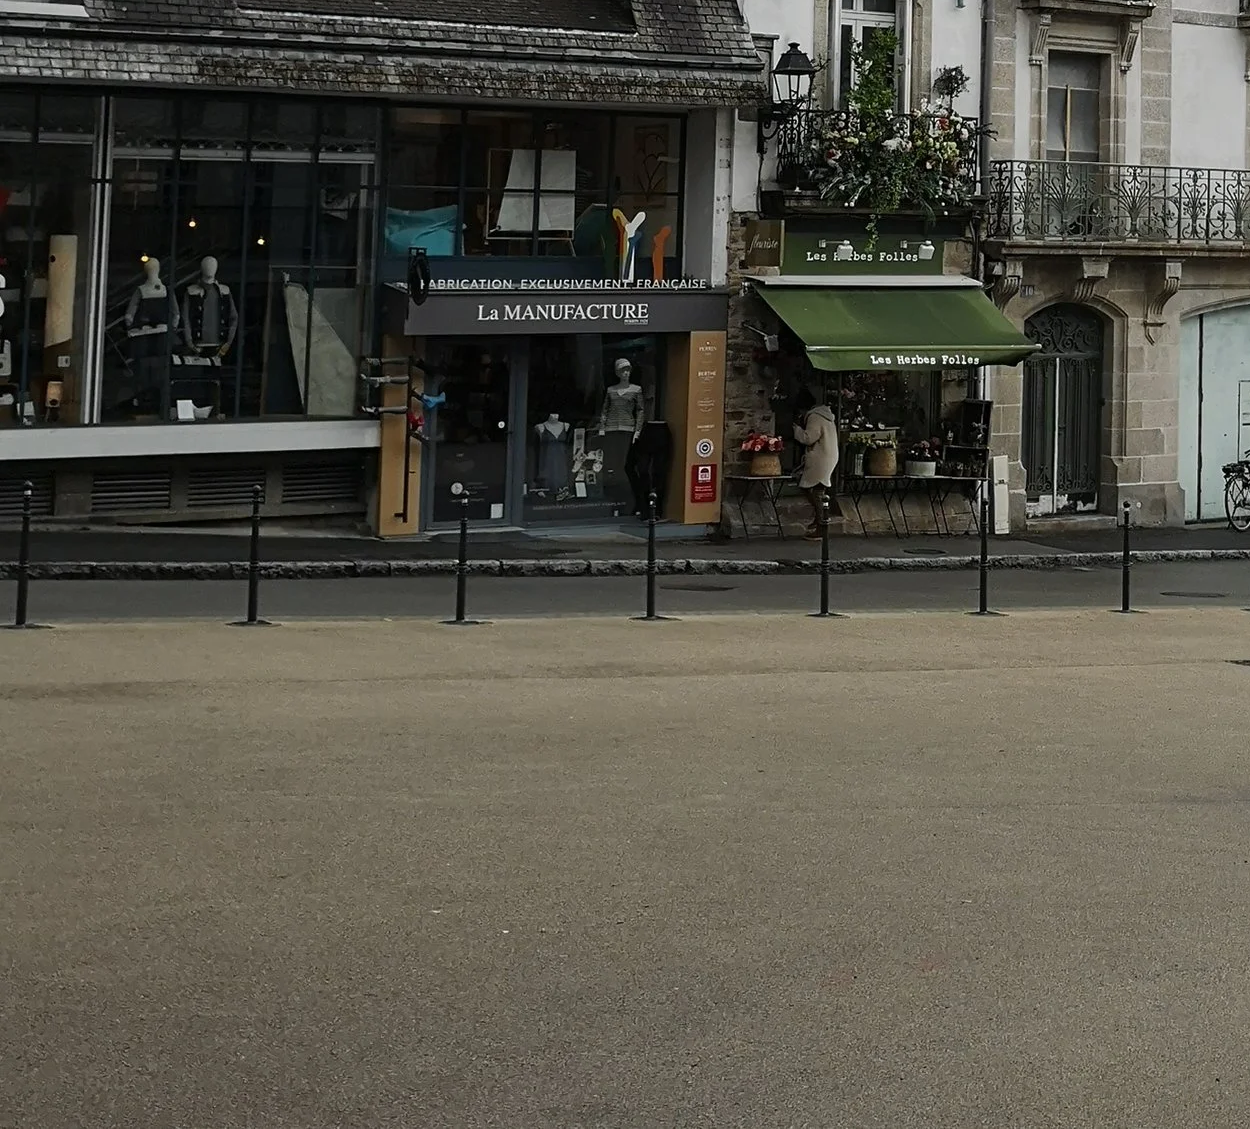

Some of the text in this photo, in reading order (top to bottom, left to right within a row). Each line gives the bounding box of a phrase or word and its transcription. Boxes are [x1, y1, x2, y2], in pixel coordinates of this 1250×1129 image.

[806, 252, 919, 262] Les Hrbes Folles
[519, 279, 628, 290] EXCLUSIVEMENT
[636, 279, 707, 291] FRANÇAISE
[477, 303, 649, 321] La MANUFACTURE
[870, 354, 980, 365] Les Herbes Folles
